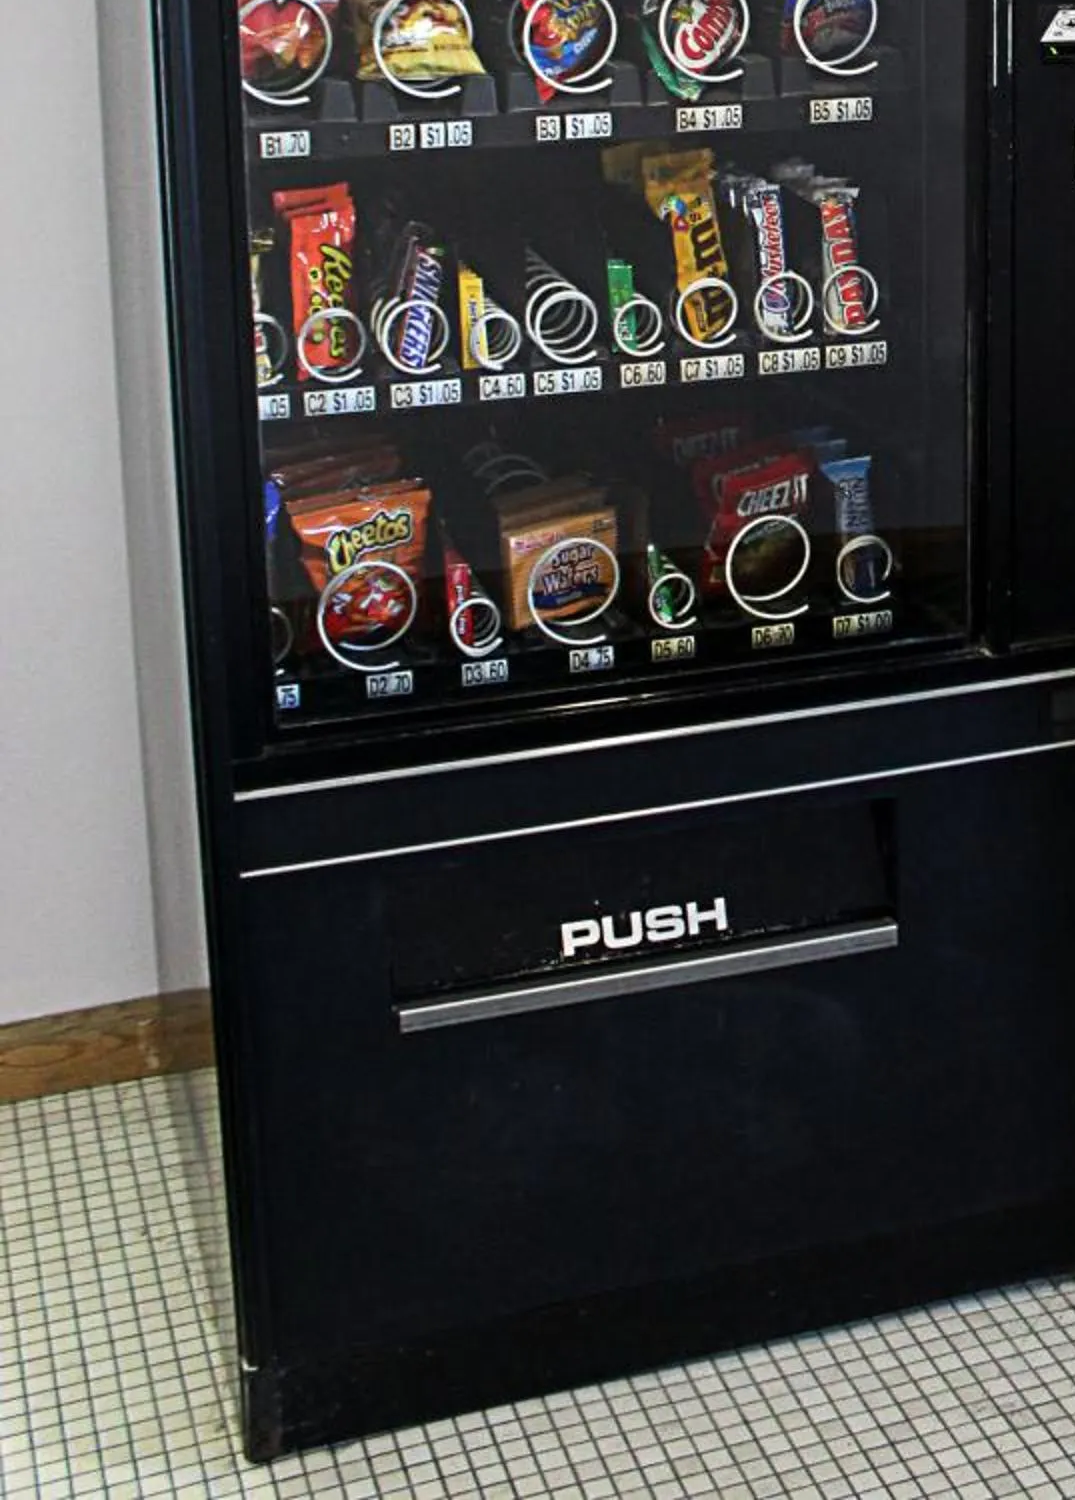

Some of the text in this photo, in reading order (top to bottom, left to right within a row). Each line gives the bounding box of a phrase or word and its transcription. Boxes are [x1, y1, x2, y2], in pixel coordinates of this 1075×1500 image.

[679, 110, 698, 129] B4
[813, 101, 831, 121] B5
[393, 127, 411, 148] B2
[540, 119, 557, 138] B3
[265, 135, 281, 156] B1
[762, 353, 779, 373] C8
[829, 347, 846, 367] C9
[624, 366, 643, 385] C6
[685, 361, 701, 380] C7
[483, 379, 501, 398] C4
[538, 373, 555, 393] C5
[308, 393, 327, 413] C2
[394, 386, 413, 406] C3
[329, 511, 408, 574] Cheetos
[755, 629, 773, 647] D6
[655, 641, 672, 659] D5
[466, 665, 484, 684] D3
[369, 677, 388, 697] D2
[561, 897, 728, 957] PUSH
